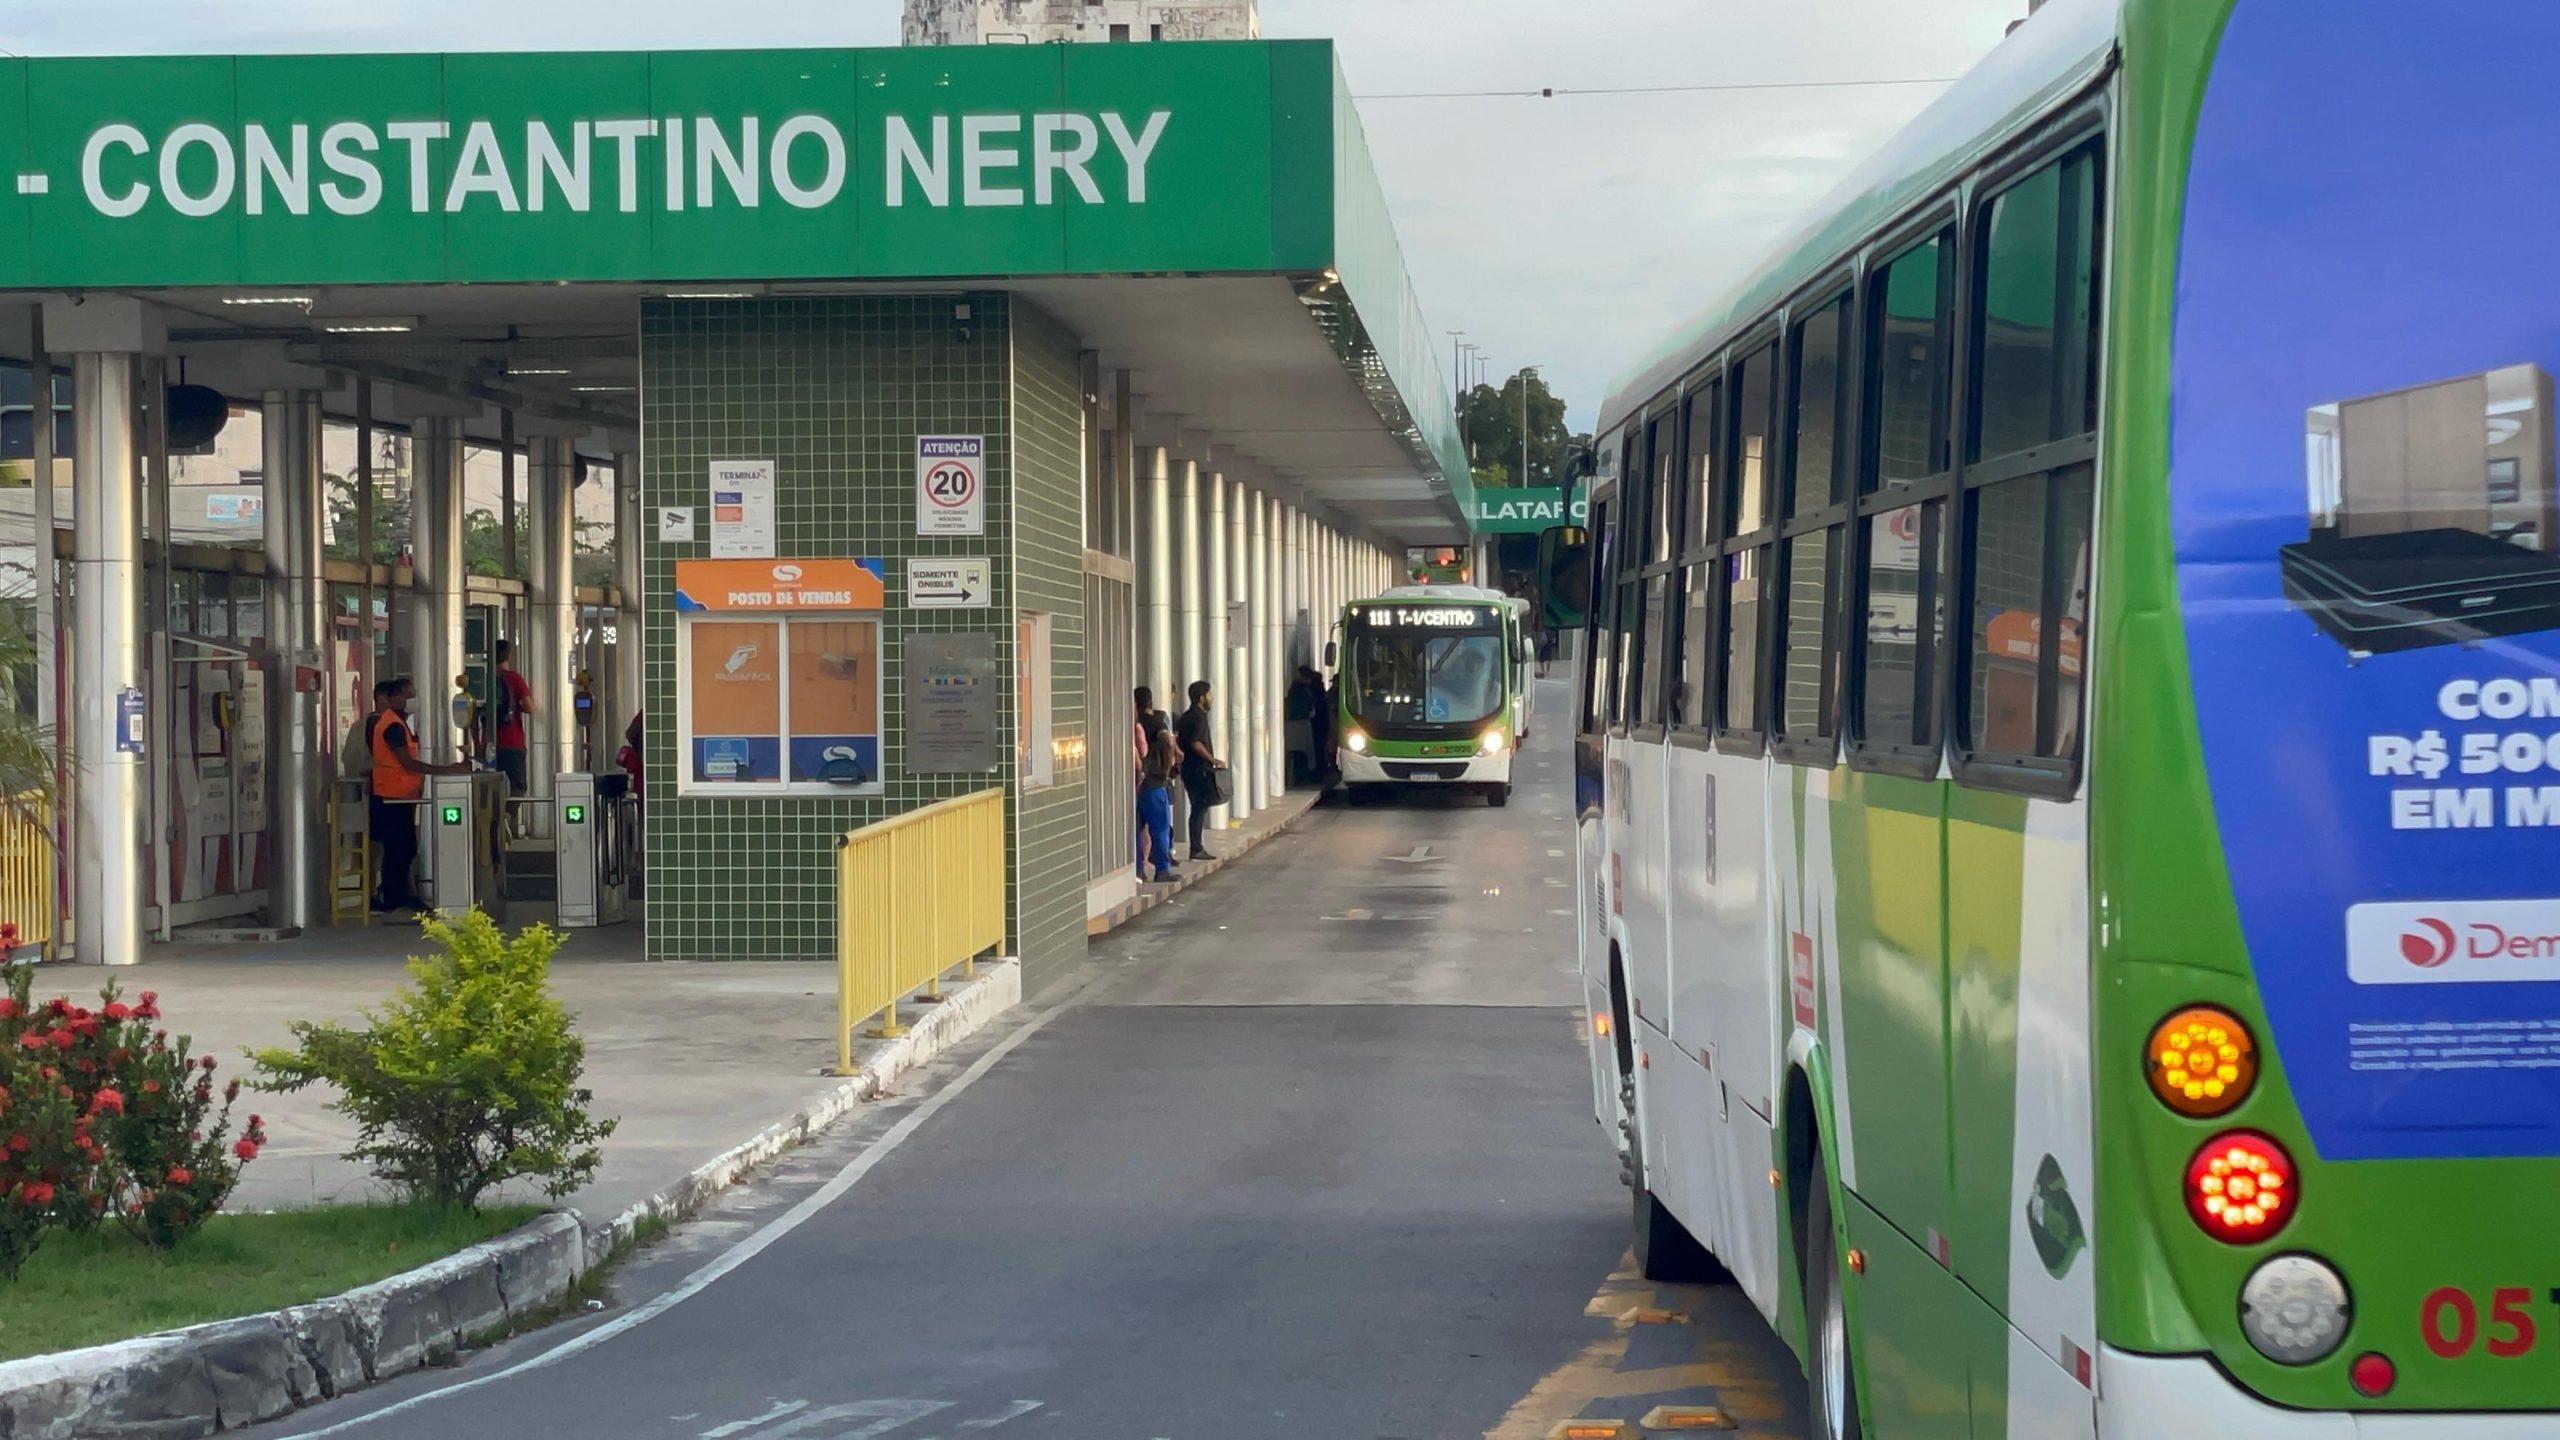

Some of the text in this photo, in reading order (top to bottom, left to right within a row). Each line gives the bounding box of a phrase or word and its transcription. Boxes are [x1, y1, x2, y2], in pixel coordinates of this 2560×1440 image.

[81, 114, 847, 217] CONSTANTINO
[886, 111, 1171, 211] NERY
[923, 441, 978, 456] ATENÇÃO
[933, 471, 967, 495] 20
[728, 591, 852, 606] POSTO DE VENDAS
[1369, 610, 1391, 626] 111
[2368, 730, 2449, 779] R$
[2391, 788, 2493, 829] EM
[2418, 1285, 2560, 1359] 05
